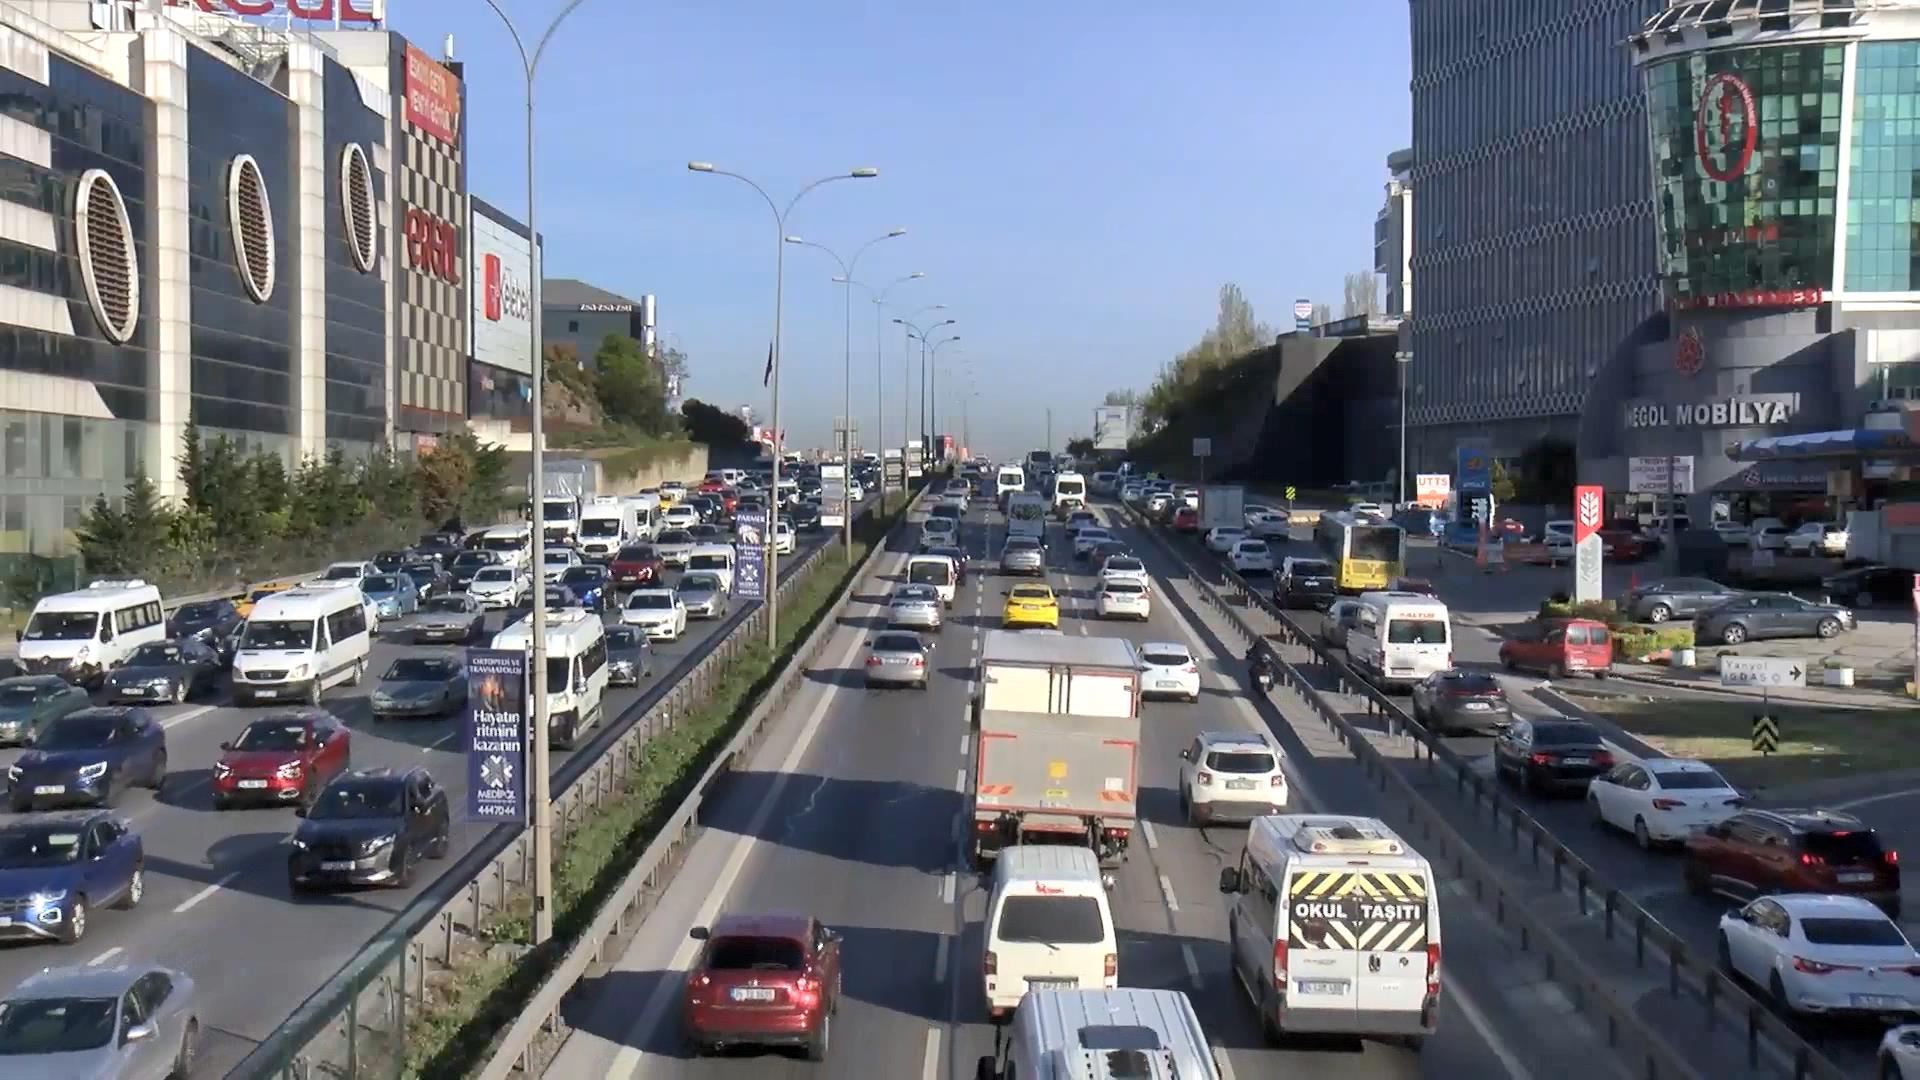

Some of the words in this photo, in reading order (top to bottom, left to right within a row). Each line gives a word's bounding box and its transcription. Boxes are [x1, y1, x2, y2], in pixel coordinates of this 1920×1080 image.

[1676, 397, 1788, 425] MOBİLYA
[1418, 477, 1448, 486] UTTS
[473, 709, 520, 726] Hayatın
[476, 723, 518, 738] ritmini
[473, 737, 521, 752] kazanın
[1295, 903, 1348, 919] OKUL
[1360, 904, 1420, 922] TAŞITI
